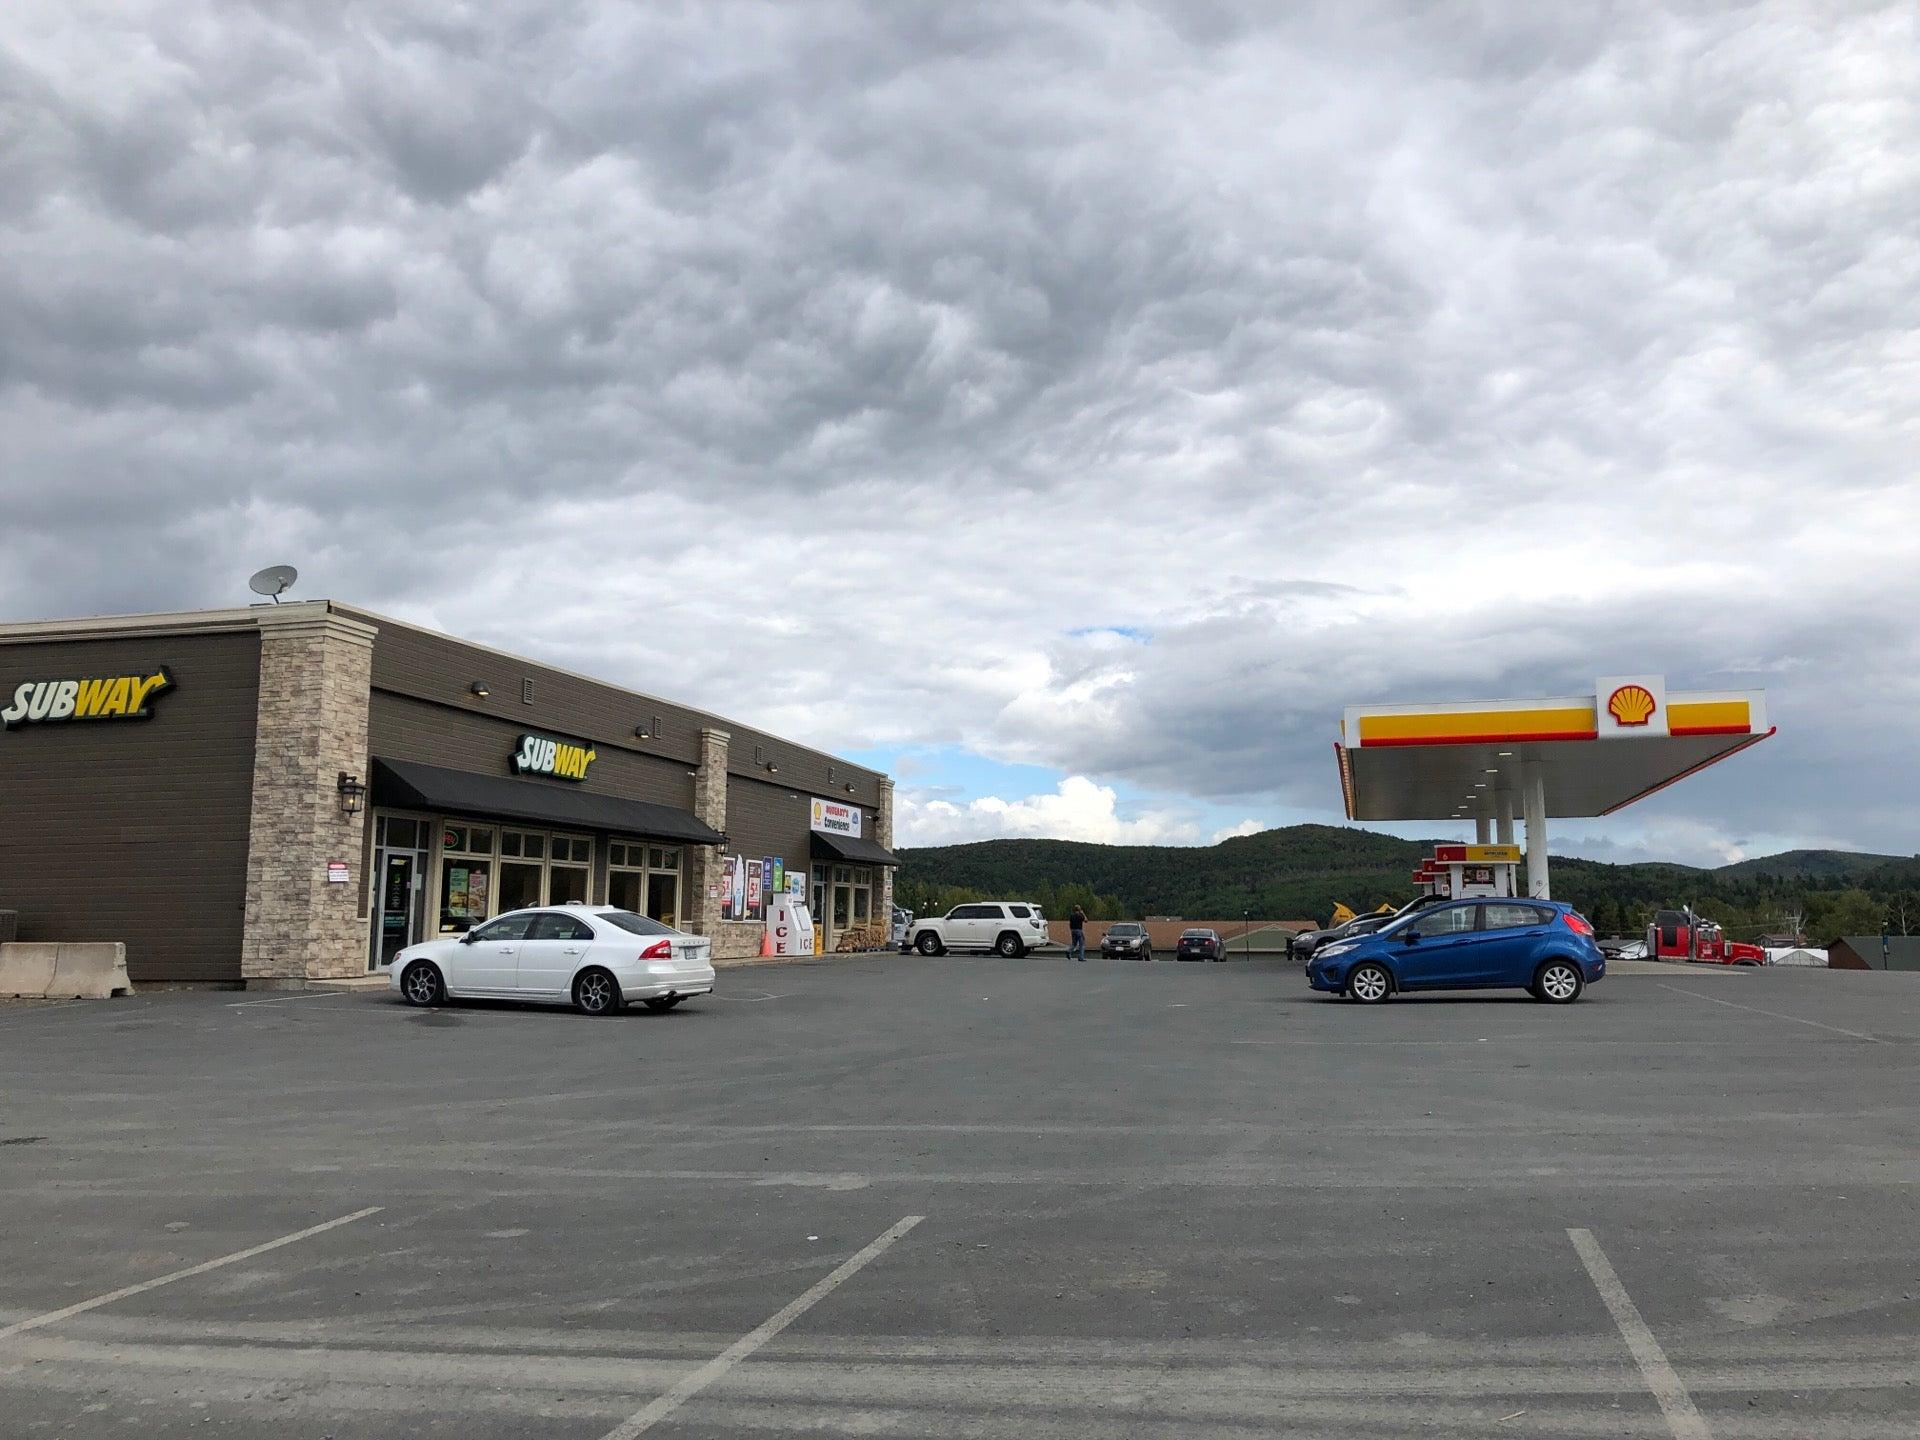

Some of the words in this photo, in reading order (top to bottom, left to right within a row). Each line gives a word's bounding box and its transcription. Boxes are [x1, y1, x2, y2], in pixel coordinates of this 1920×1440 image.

[1, 672, 167, 722] SUBWAY
[517, 736, 596, 779] SUBWAY
[824, 816, 850, 832] Convenience
[775, 909, 788, 954] ICE
[799, 938, 814, 950] ICE
